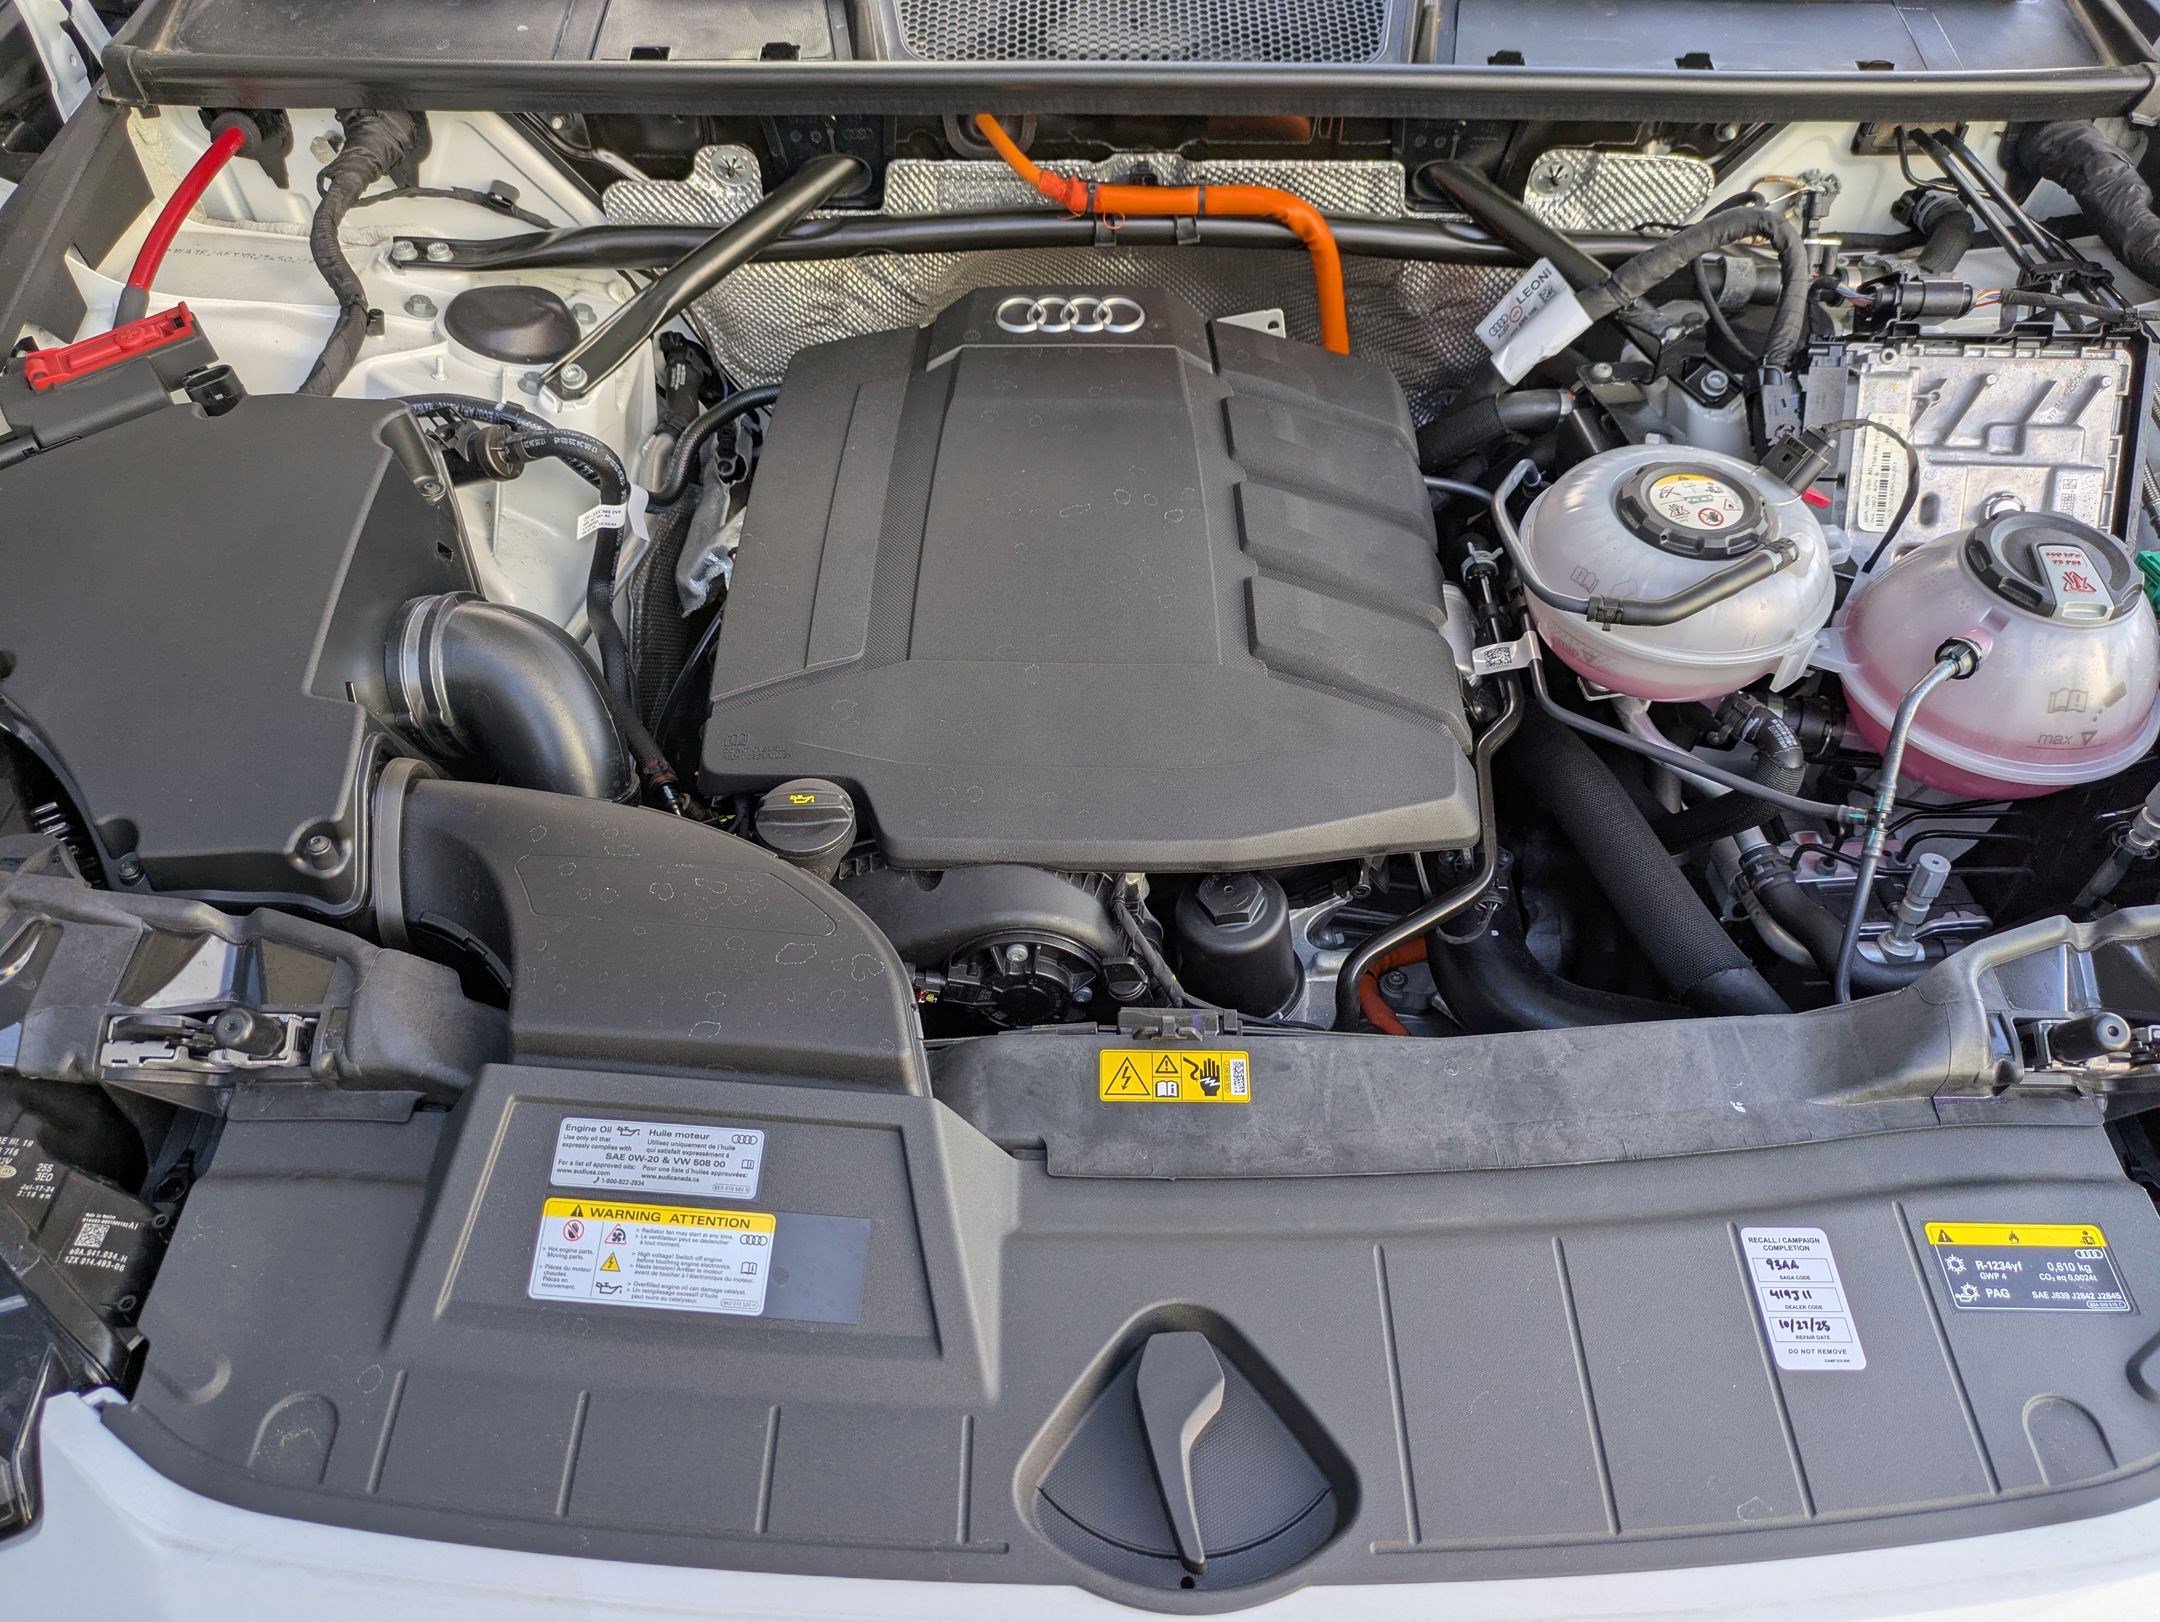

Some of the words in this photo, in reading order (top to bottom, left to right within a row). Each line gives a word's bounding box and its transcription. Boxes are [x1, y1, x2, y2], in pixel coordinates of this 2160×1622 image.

[1516, 267, 1552, 304] LEONI
[2038, 732, 2073, 745] max
[564, 1124, 597, 1134] Engine
[599, 1125, 612, 1133] Oil
[648, 1128, 672, 1137] Huile
[674, 1131, 710, 1139] moteur
[561, 1142, 590, 1150] expressly
[590, 1143, 618, 1151] complies
[670, 1141, 707, 1149] uniquement
[604, 1152, 625, 1160] SAE
[627, 1154, 659, 1163] 0W-20
[672, 1157, 691, 1165] VW
[556, 1167, 611, 1176] www.audiusa.com
[600, 1177, 645, 1186] 1-800-822-2834
[640, 1173, 700, 1182] www.audicanada.ca
[589, 1207, 661, 1221] WARNING
[669, 1213, 750, 1228] ATTENTION
[1975, 1260, 2023, 1272] R-1234yf
[2077, 1263, 2092, 1274] kg
[1979, 1272, 2000, 1280] GWP
[1985, 1288, 2011, 1299] PAG
[2032, 1291, 2050, 1299] SAE
[1779, 1318, 1830, 1332] 10/27/25
